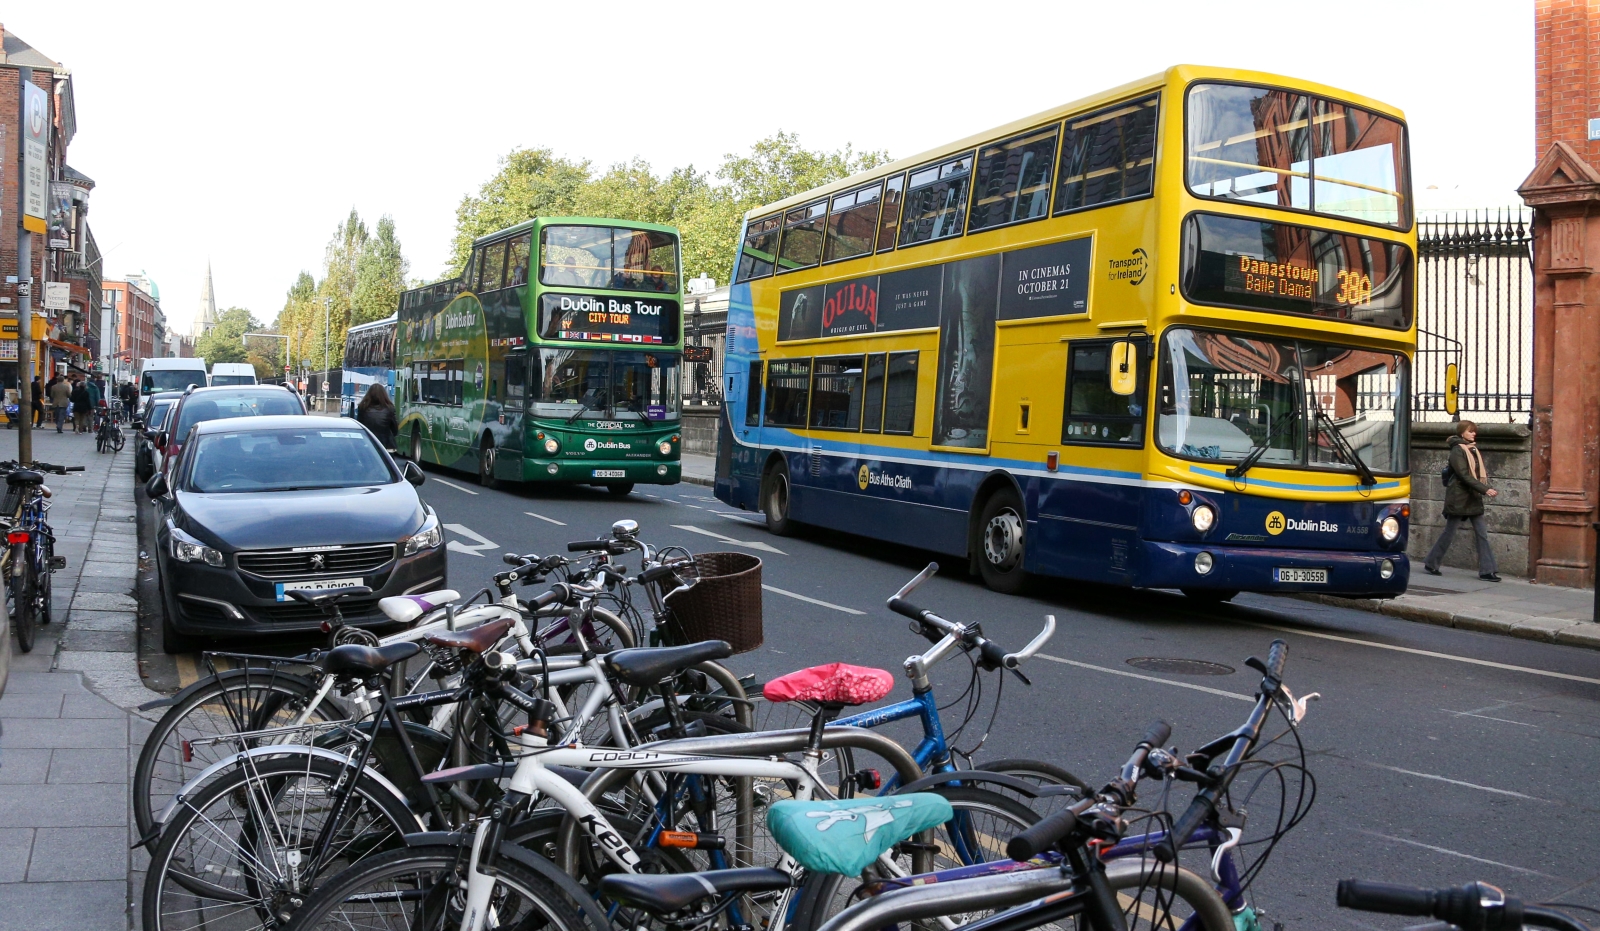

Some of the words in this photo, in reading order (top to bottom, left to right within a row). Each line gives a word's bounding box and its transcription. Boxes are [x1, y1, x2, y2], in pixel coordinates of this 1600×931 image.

[1109, 255, 1143, 269] Transport
[1240, 255, 1319, 283] Damastown
[1019, 270, 1028, 281] IN
[1031, 263, 1071, 280] CINEMAS
[1108, 271, 1117, 281] for
[1117, 267, 1142, 280] Ireland
[1017, 281, 1058, 295] OCTOBER
[1060, 279, 1069, 290] 21
[1246, 273, 1275, 294] Baile
[1279, 278, 1312, 299] Dama
[1336, 269, 1372, 306] 38A
[913, 290, 929, 298] NEVER
[560, 297, 605, 313] Dublin
[608, 300, 632, 314] Bus
[635, 301, 662, 316] Tour
[823, 283, 876, 328] OUIJA
[895, 302, 907, 311] JUST
[913, 299, 927, 308] GAME
[446, 314, 459, 329] Dublin
[459, 311, 467, 328] Bus
[467, 310, 476, 327] Tour
[588, 312, 607, 323] CITY
[610, 314, 630, 325] TOUR
[830, 326, 848, 334] ORIGIN
[596, 421, 623, 430] OFFICIAL
[597, 441, 618, 450] Dublin
[618, 442, 631, 450] Bus
[869, 472, 880, 484] Bus
[880, 470, 894, 487] Átha
[894, 475, 912, 489] Cliath
[1286, 518, 1319, 532] Dublin
[1319, 521, 1339, 533] Bus
[1280, 570, 1325, 582] 06-D-30558
[511, 693, 533, 708] UNO
